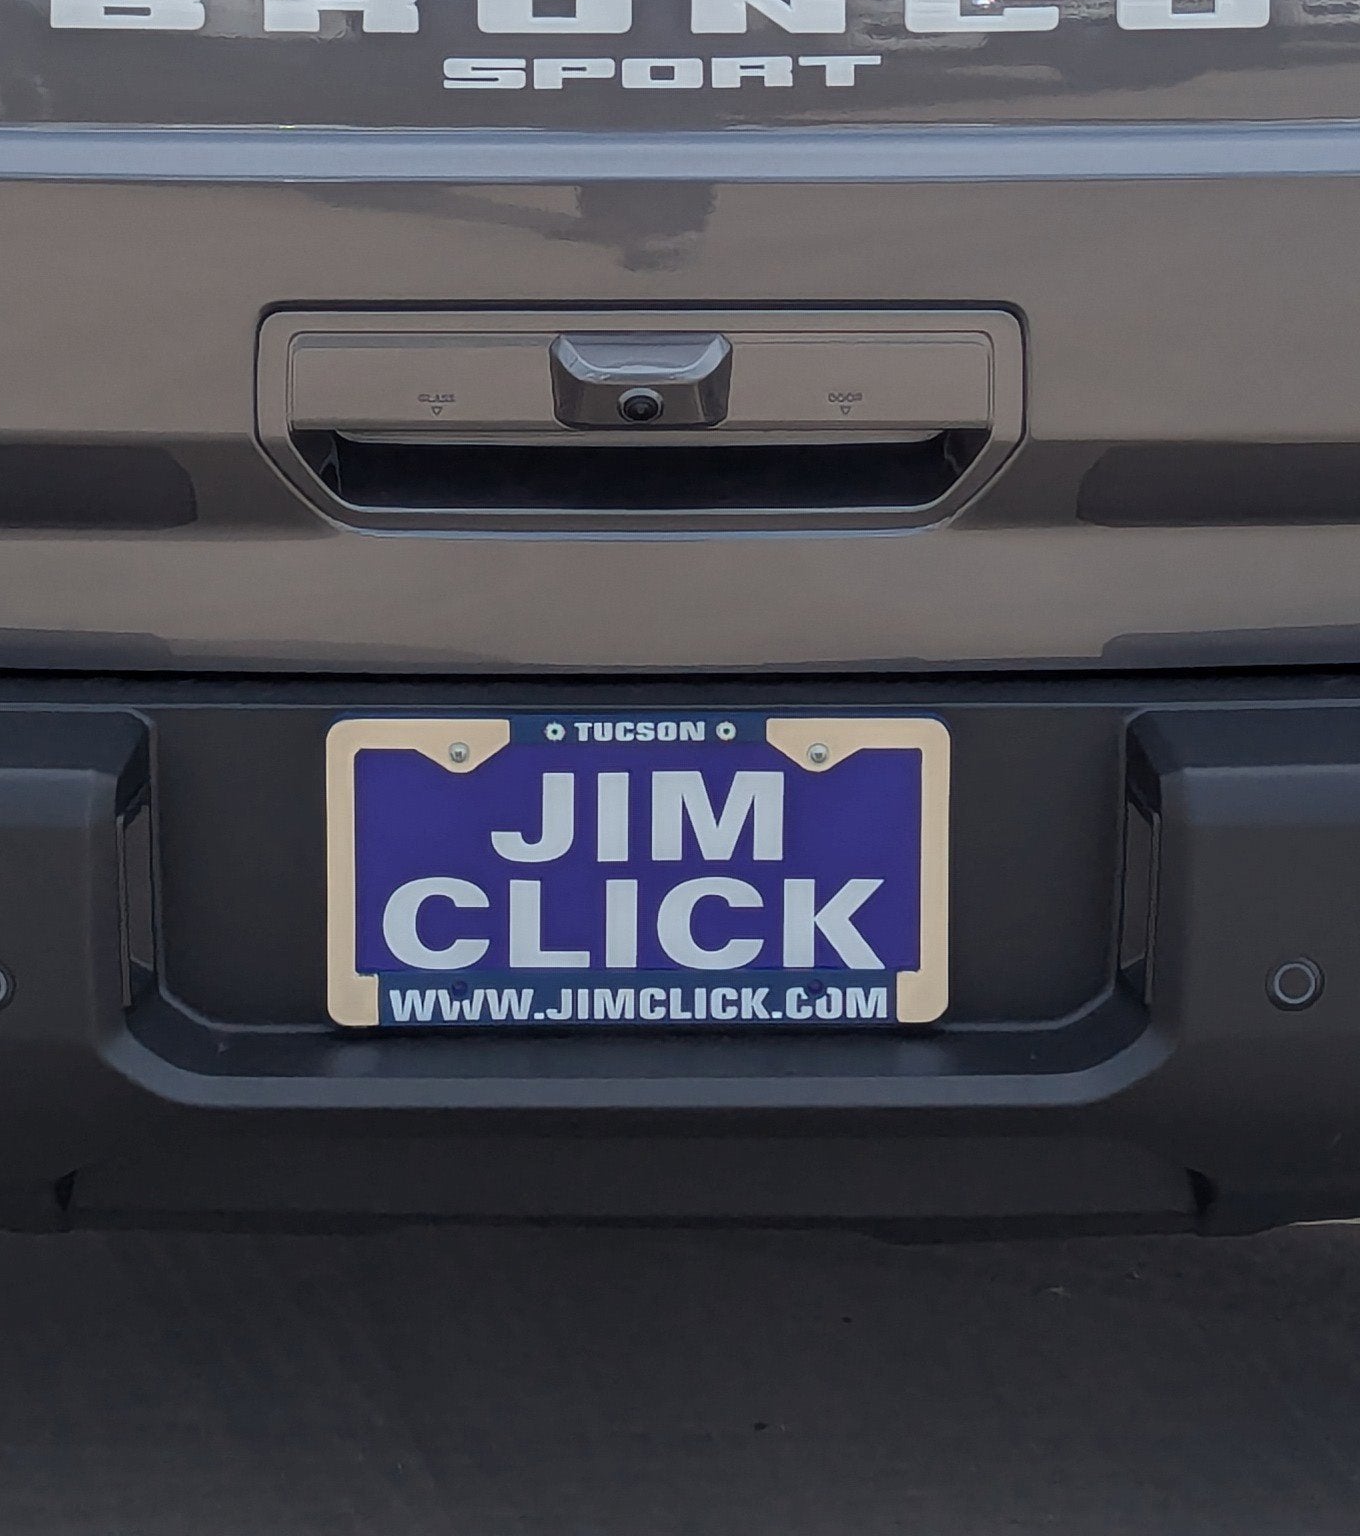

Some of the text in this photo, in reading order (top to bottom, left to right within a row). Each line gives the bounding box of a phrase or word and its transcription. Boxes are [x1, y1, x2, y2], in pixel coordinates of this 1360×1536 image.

[442, 55, 881, 90] SPORT
[574, 721, 706, 743] TUCSON
[490, 770, 785, 863] JIM
[382, 876, 886, 970] CLICK
[389, 985, 888, 1023] WWW.JIMCLICK.COM
